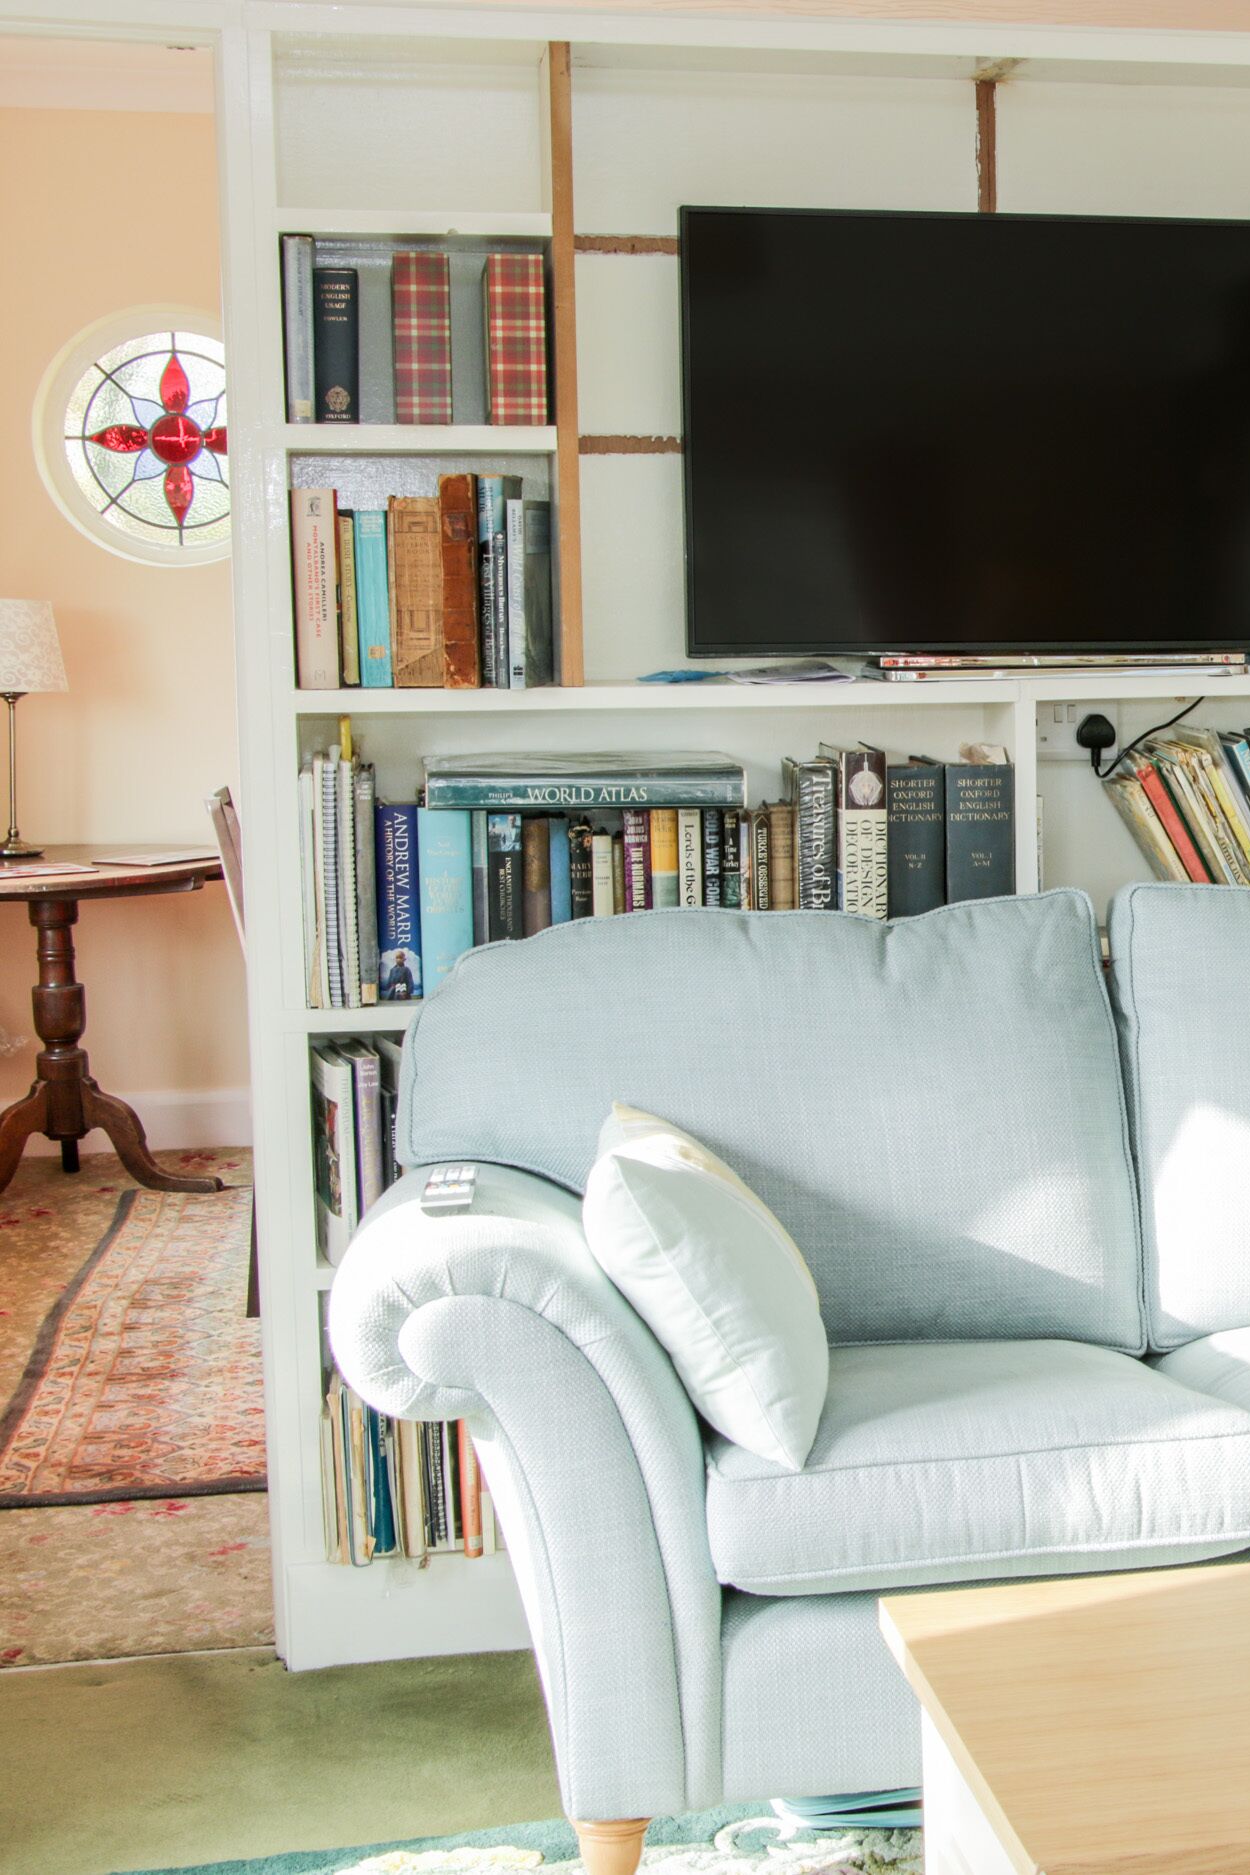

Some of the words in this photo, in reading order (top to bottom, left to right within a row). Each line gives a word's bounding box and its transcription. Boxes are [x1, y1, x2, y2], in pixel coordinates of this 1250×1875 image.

[482, 553, 495, 579] Lost
[480, 580, 495, 625] Villages
[890, 778, 936, 789] SHORTER
[957, 777, 1003, 788] SHORTER
[527, 787, 594, 802] WORLD
[599, 786, 648, 802] ATLAS
[893, 790, 935, 800] OXFORD
[960, 789, 1000, 799] OXFORD
[893, 802, 935, 811] ENGLISH
[959, 800, 1001, 810] ENGLISH
[384, 819, 392, 827] A
[626, 815, 643, 825] JOHN
[811, 770, 832, 861] Treasures
[888, 812, 944, 822] ICTIONARY
[950, 811, 1010, 822] DICTIONARY
[626, 825, 645, 834] JULIUS
[860, 819, 873, 841] OF
[624, 834, 648, 843] NORWICH
[684, 823, 695, 859] Lords
[729, 837, 734, 845] A
[757, 827, 769, 863] TURKEY
[384, 827, 394, 868] HISTORY
[393, 812, 410, 889] ANDREW
[631, 847, 644, 861] THE
[724, 845, 738, 854] Time
[684, 861, 695, 872] of
[705, 847, 720, 876] WAR
[723, 860, 739, 869] Turkey
[385, 868, 395, 882] OF
[498, 868, 506, 884] BEST
[505, 856, 513, 894] ENGLAND'S
[812, 863, 832, 885] of
[860, 848, 873, 908] DESIGN
[631, 862, 646, 907] NORMANS
[684, 873, 697, 894] the
[758, 864, 770, 910] OBSERVED
[386, 883, 395, 902] THE
[395, 894, 412, 946] MARR
[506, 894, 514, 932] THOUSAND
[387, 904, 397, 940] WORLD
